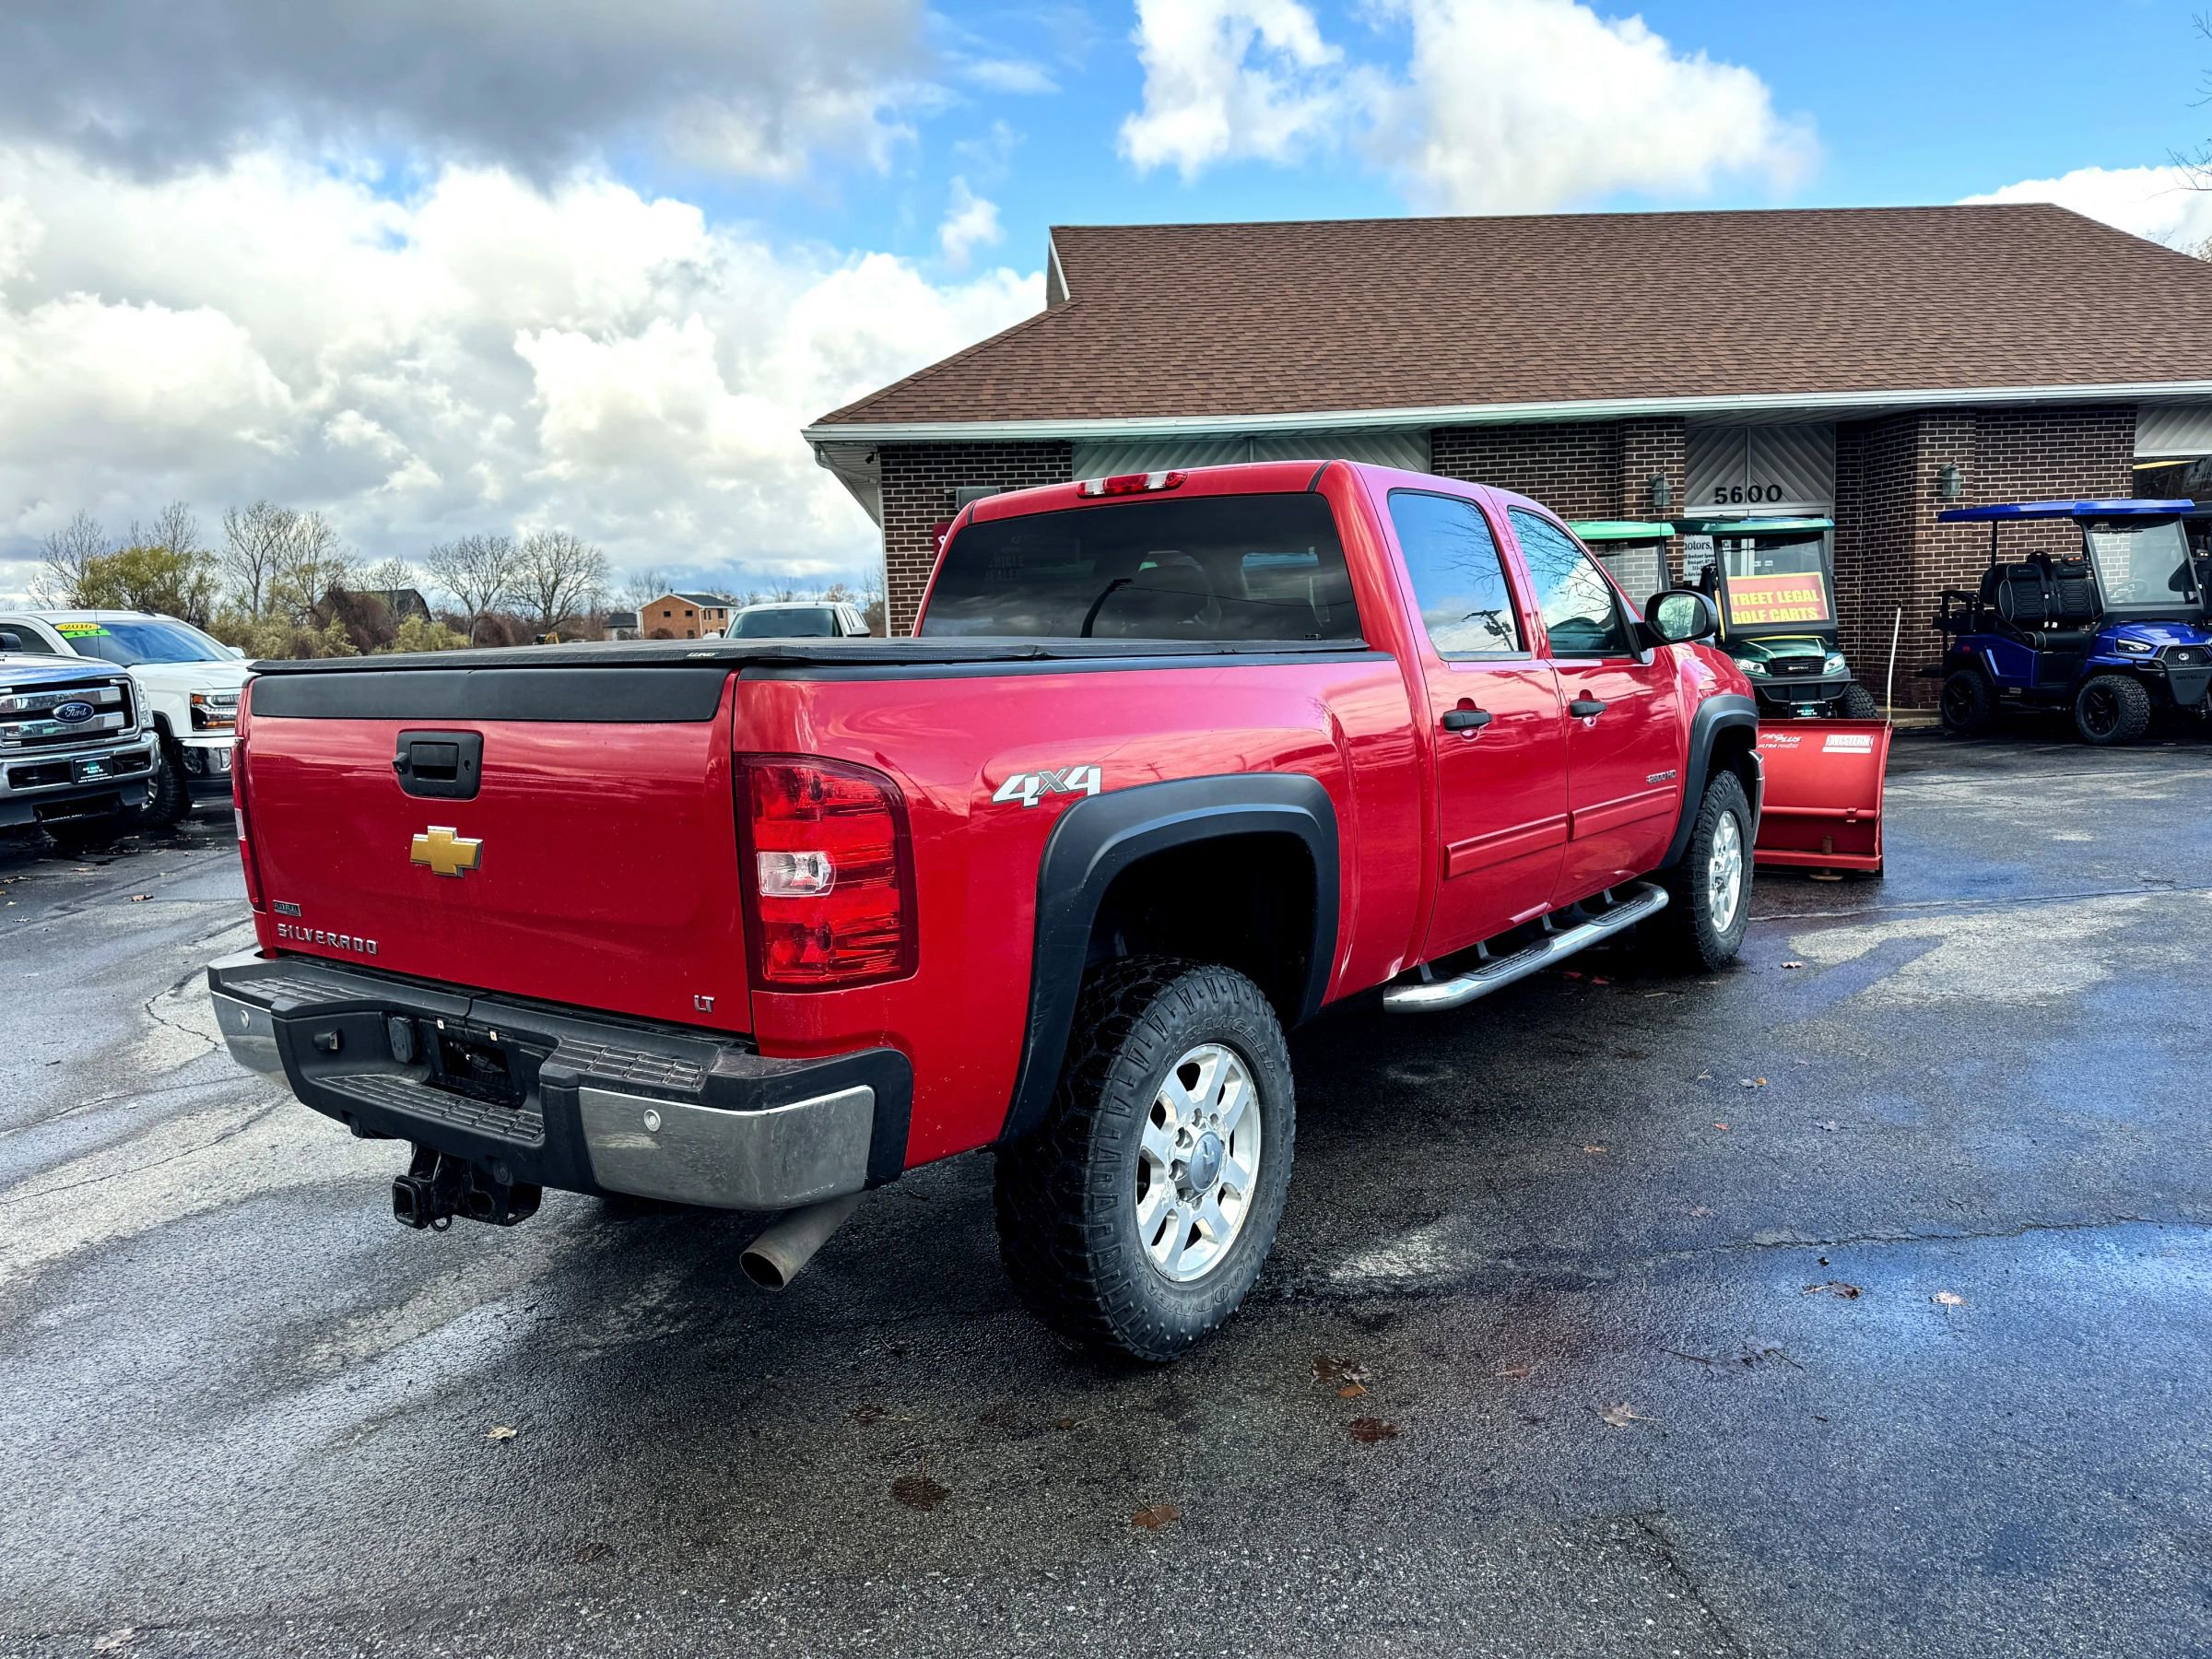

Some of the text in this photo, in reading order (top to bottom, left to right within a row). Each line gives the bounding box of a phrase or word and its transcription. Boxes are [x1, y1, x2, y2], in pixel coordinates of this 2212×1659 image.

[1714, 485, 1783, 504] 5600
[1730, 589, 1820, 606] TREET LEGAL
[1733, 606, 1818, 624] GOLF CARTS
[65, 705, 88, 718] Ford
[1828, 735, 1871, 747] WESTERN
[277, 923, 379, 954] SILVERADO
[694, 994, 715, 1013] LT
